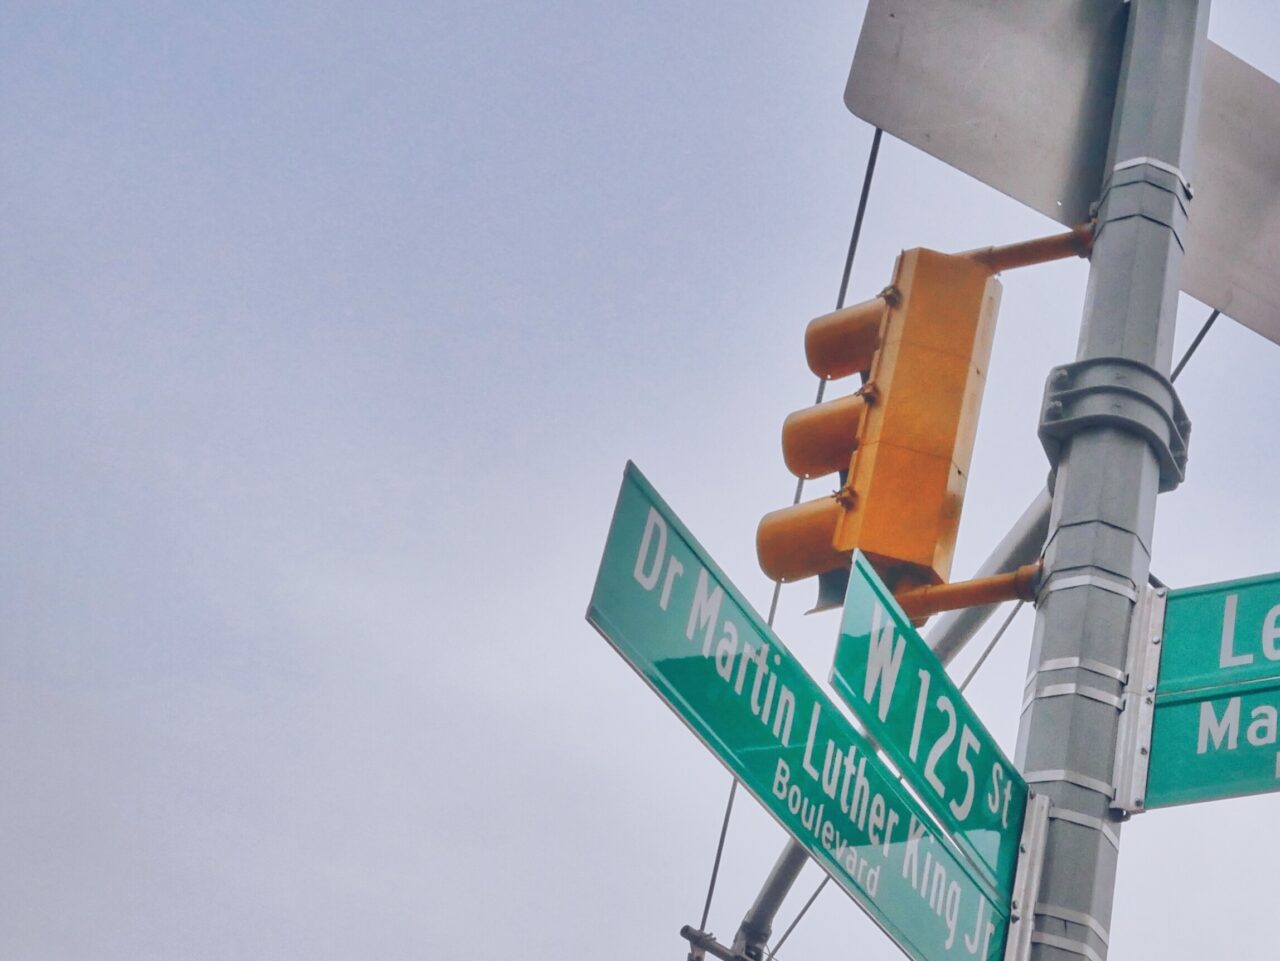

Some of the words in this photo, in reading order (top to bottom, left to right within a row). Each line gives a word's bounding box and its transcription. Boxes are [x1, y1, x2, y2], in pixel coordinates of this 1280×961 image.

[633, 506, 684, 611] Dr
[686, 567, 796, 747] Martin
[802, 702, 899, 857] Luther
[902, 811, 962, 950] King
[772, 758, 880, 898] Boulevard
[863, 600, 907, 723] W
[908, 668, 981, 821] 125
[987, 762, 1012, 829] St
